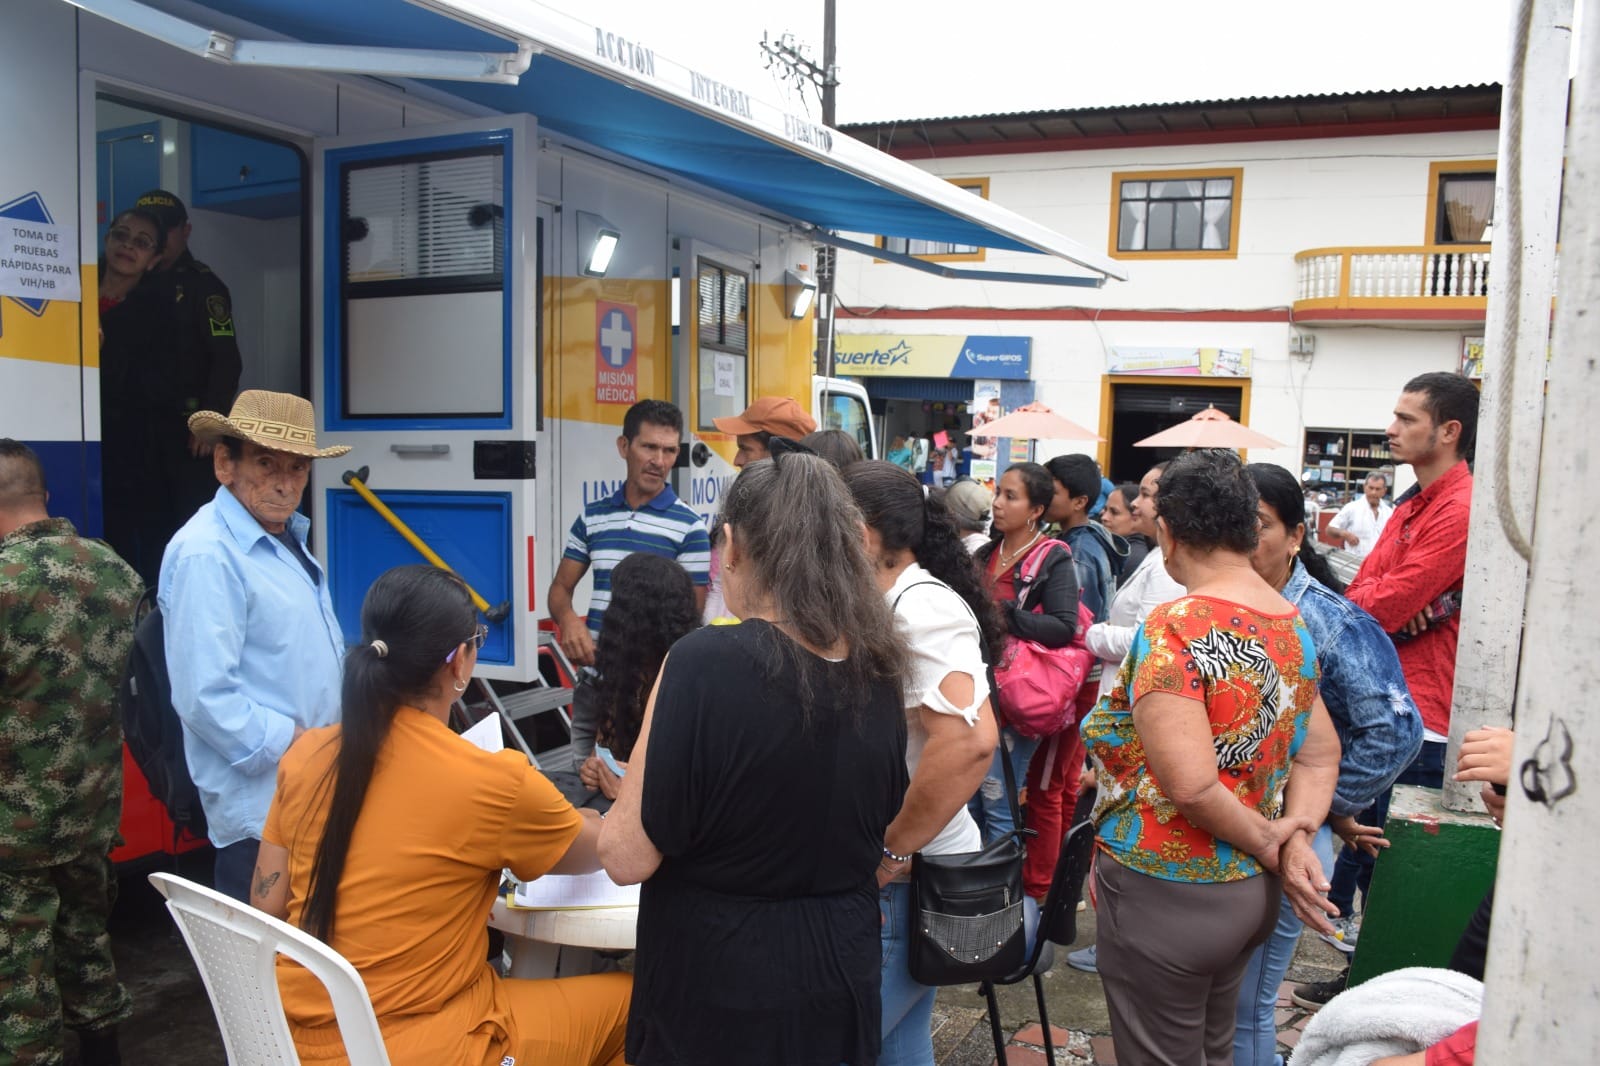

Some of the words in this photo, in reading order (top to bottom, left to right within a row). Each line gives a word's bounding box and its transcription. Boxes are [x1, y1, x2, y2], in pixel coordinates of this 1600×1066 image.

[595, 27, 655, 77] ACCIÓN
[689, 70, 753, 120] INTEGRAL
[12, 228, 44, 241] TOMA
[46, 232, 59, 243] DE
[14, 244, 59, 258] PRUEBAS
[1, 259, 44, 272] RÁPIDAS
[46, 264, 72, 275] PARA
[20, 277, 56, 289] VIH/HB
[598, 372, 634, 386] MISIÓN
[597, 385, 635, 402] MÉDICA
